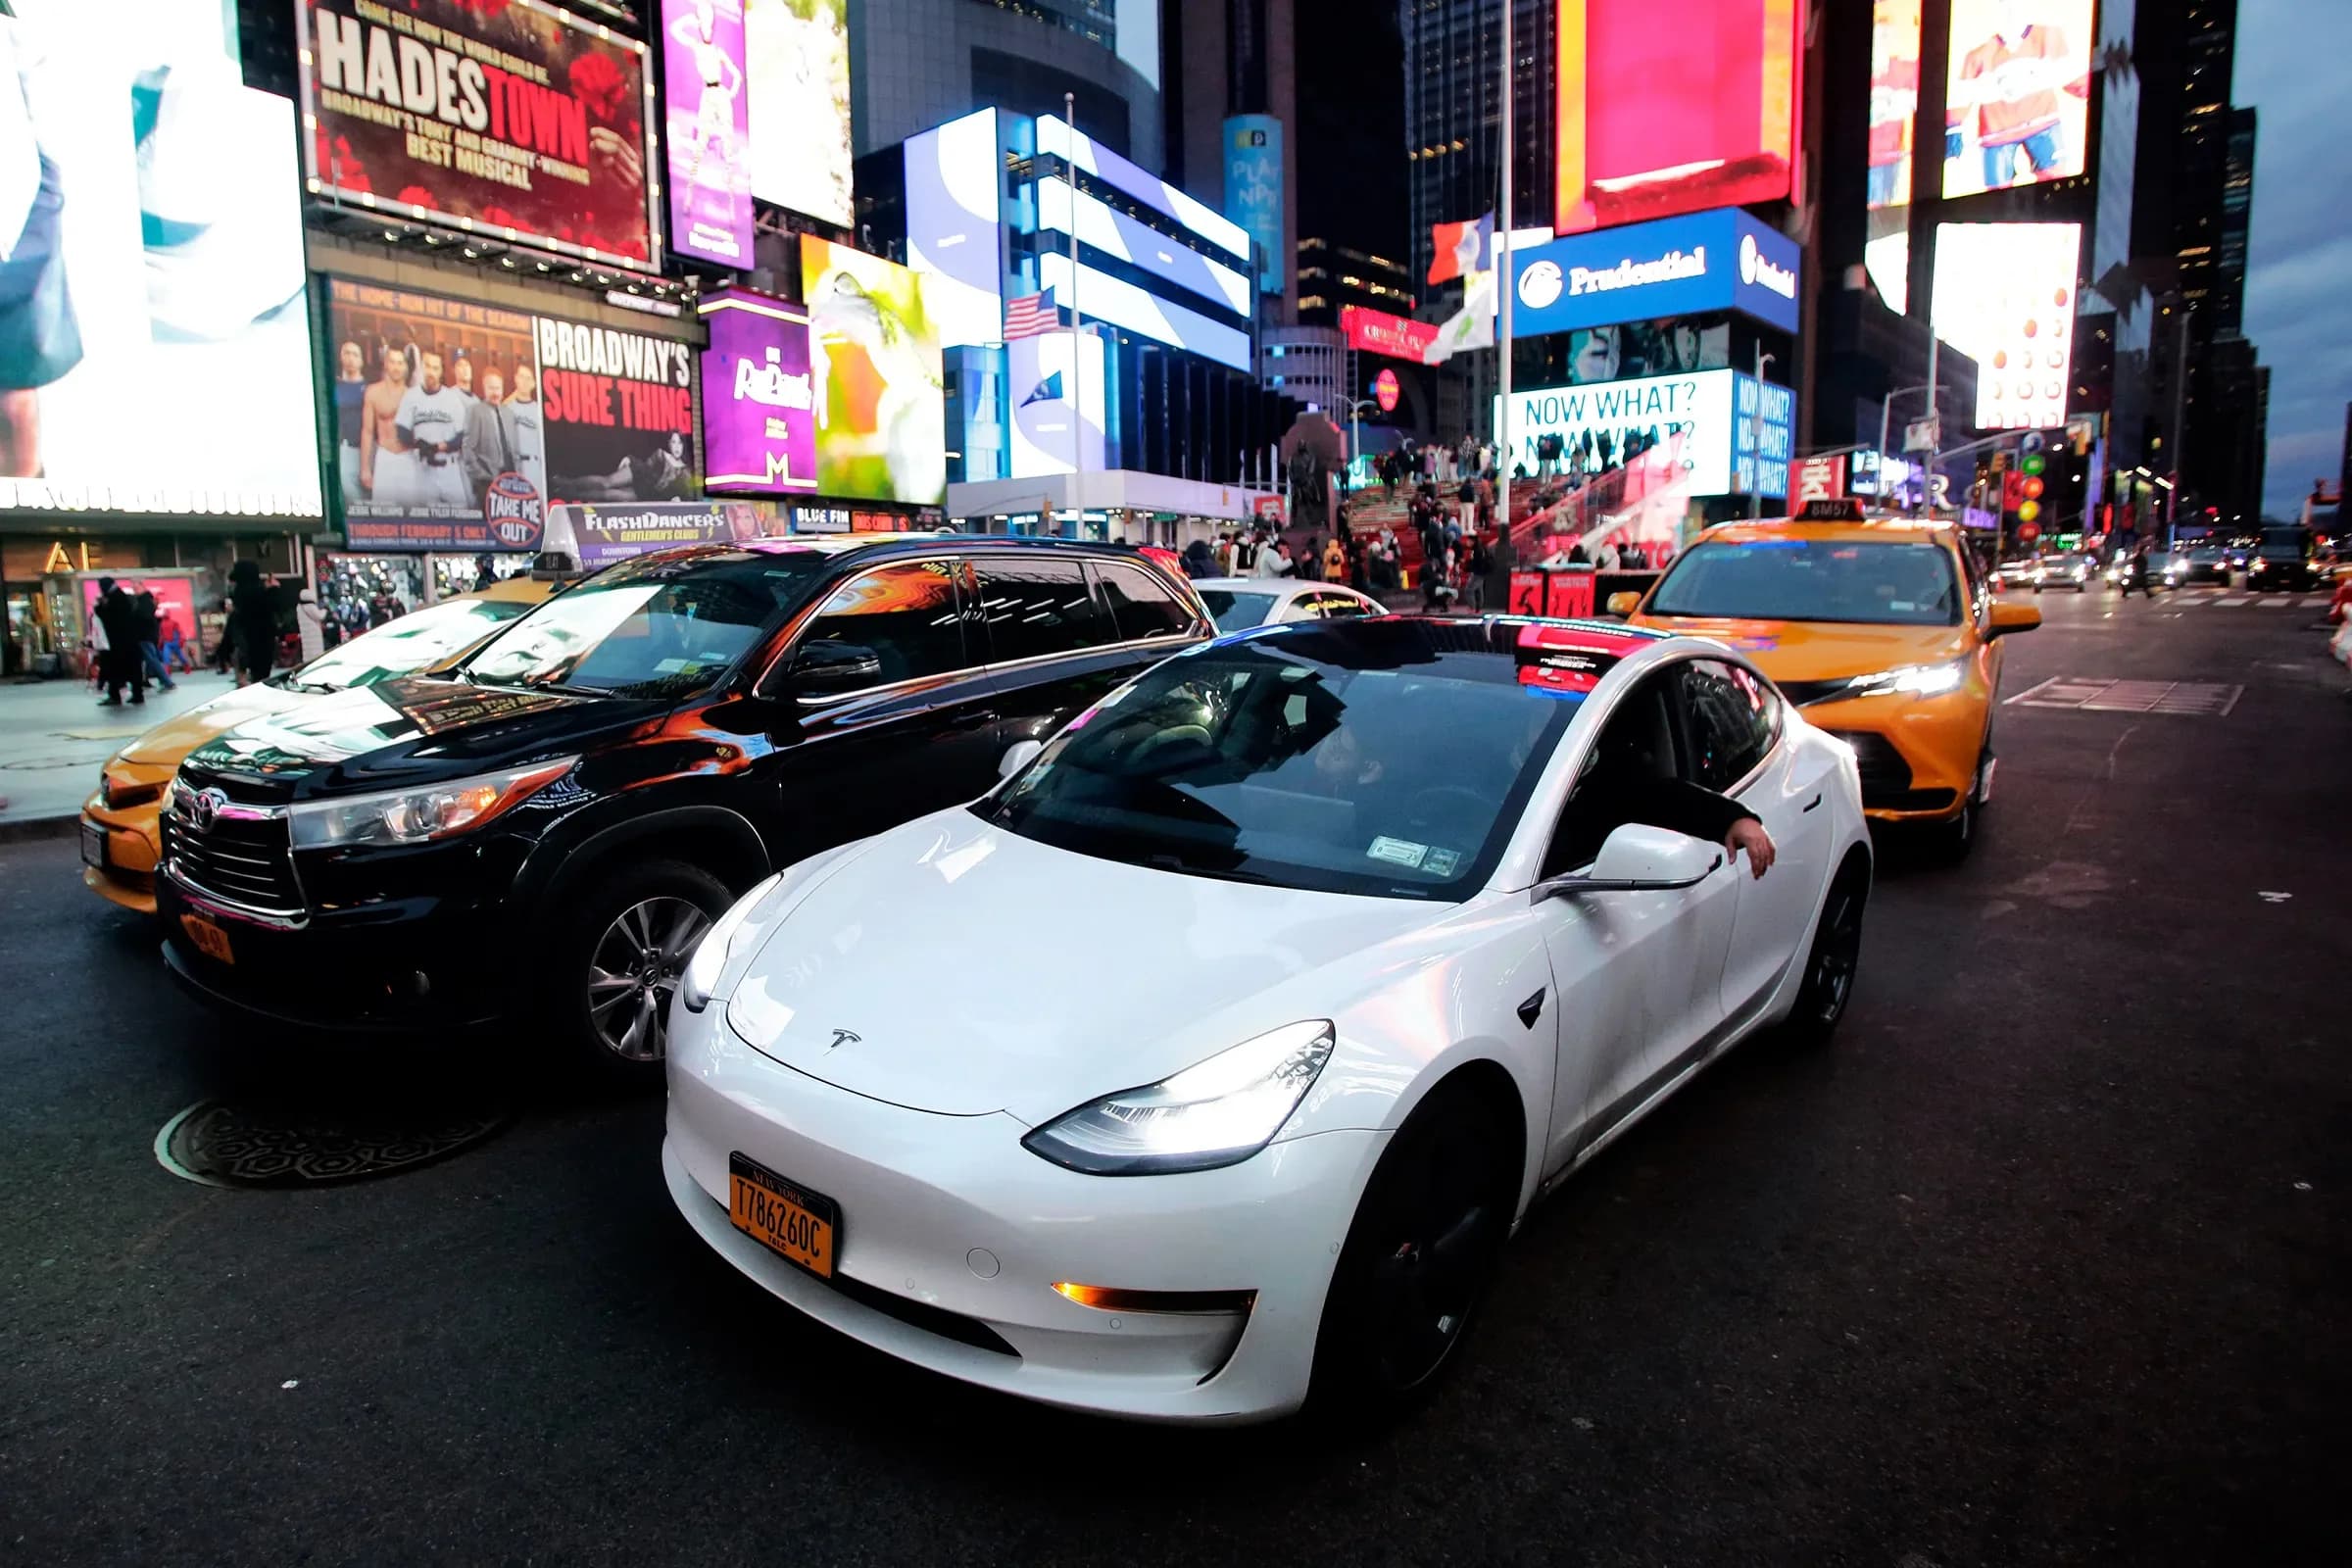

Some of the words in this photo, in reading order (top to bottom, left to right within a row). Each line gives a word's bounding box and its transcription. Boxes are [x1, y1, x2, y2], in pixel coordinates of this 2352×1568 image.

[321, 88, 416, 133] BROADWAY'S
[407, 131, 453, 169] BEST
[455, 146, 532, 191] MUSICAL
[1569, 246, 1706, 296] Prudential
[540, 317, 690, 387] BROADWAY'S
[543, 368, 615, 427] SURE
[616, 378, 692, 435] THING
[1526, 394, 1585, 426] NOW
[1595, 381, 1696, 419] WHAT?
[1761, 384, 1790, 424] WHAT?
[1761, 418, 1789, 460] WHAT?
[1759, 458, 1788, 496] WHAT?
[490, 492, 520, 518] TAKE
[521, 499, 541, 525] ME
[797, 508, 827, 523] BLUE
[501, 521, 529, 543] OUT
[601, 546, 642, 558] DOWNTOWN
[754, 1169, 774, 1191] NEW
[778, 1184, 805, 1207] YORK
[737, 1178, 820, 1257] T786260C
